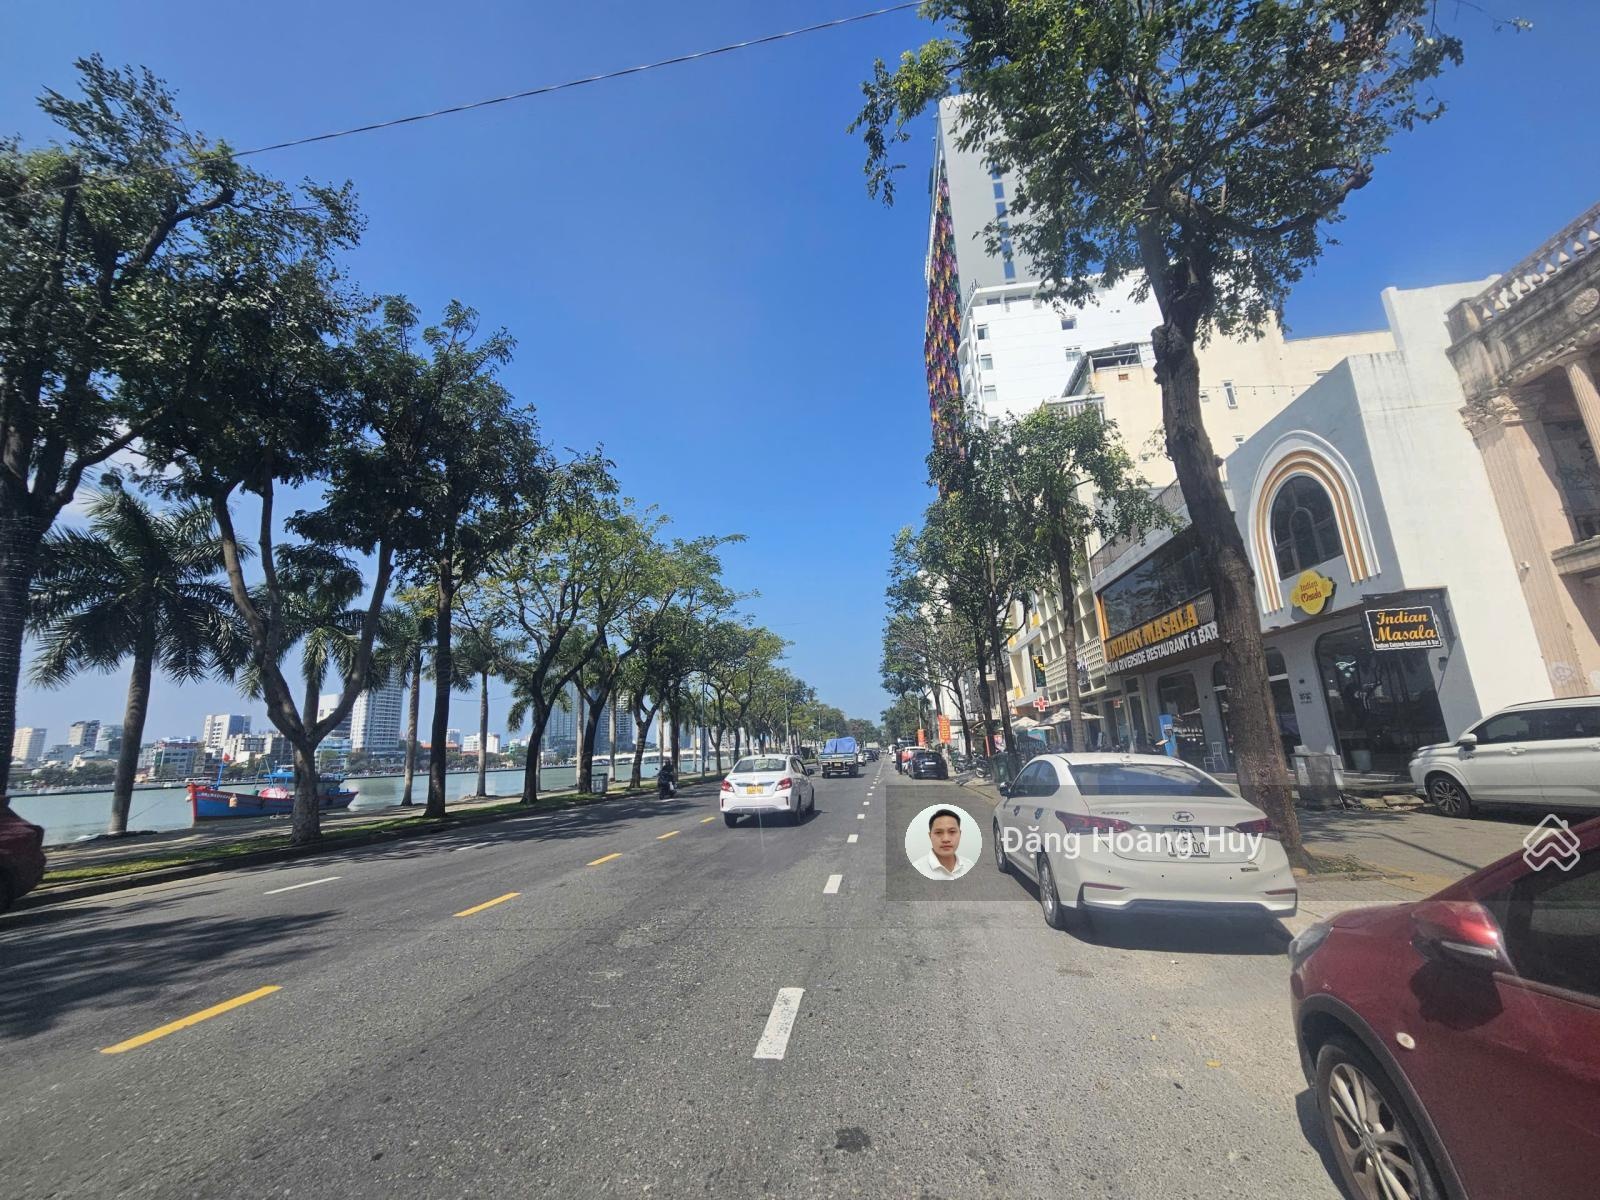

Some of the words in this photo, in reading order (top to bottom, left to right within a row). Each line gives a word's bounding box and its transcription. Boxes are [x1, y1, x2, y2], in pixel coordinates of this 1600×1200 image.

[1301, 588, 1321, 603] Masala
[1142, 603, 1199, 644] MASALA
[1376, 610, 1429, 625] Indian
[1375, 625, 1436, 642] Masala
[1119, 650, 1146, 671] RIVERSIDE
[1146, 635, 1190, 662] RESTAURANT
[1191, 631, 1198, 647] &
[1198, 621, 1219, 643] BAR
